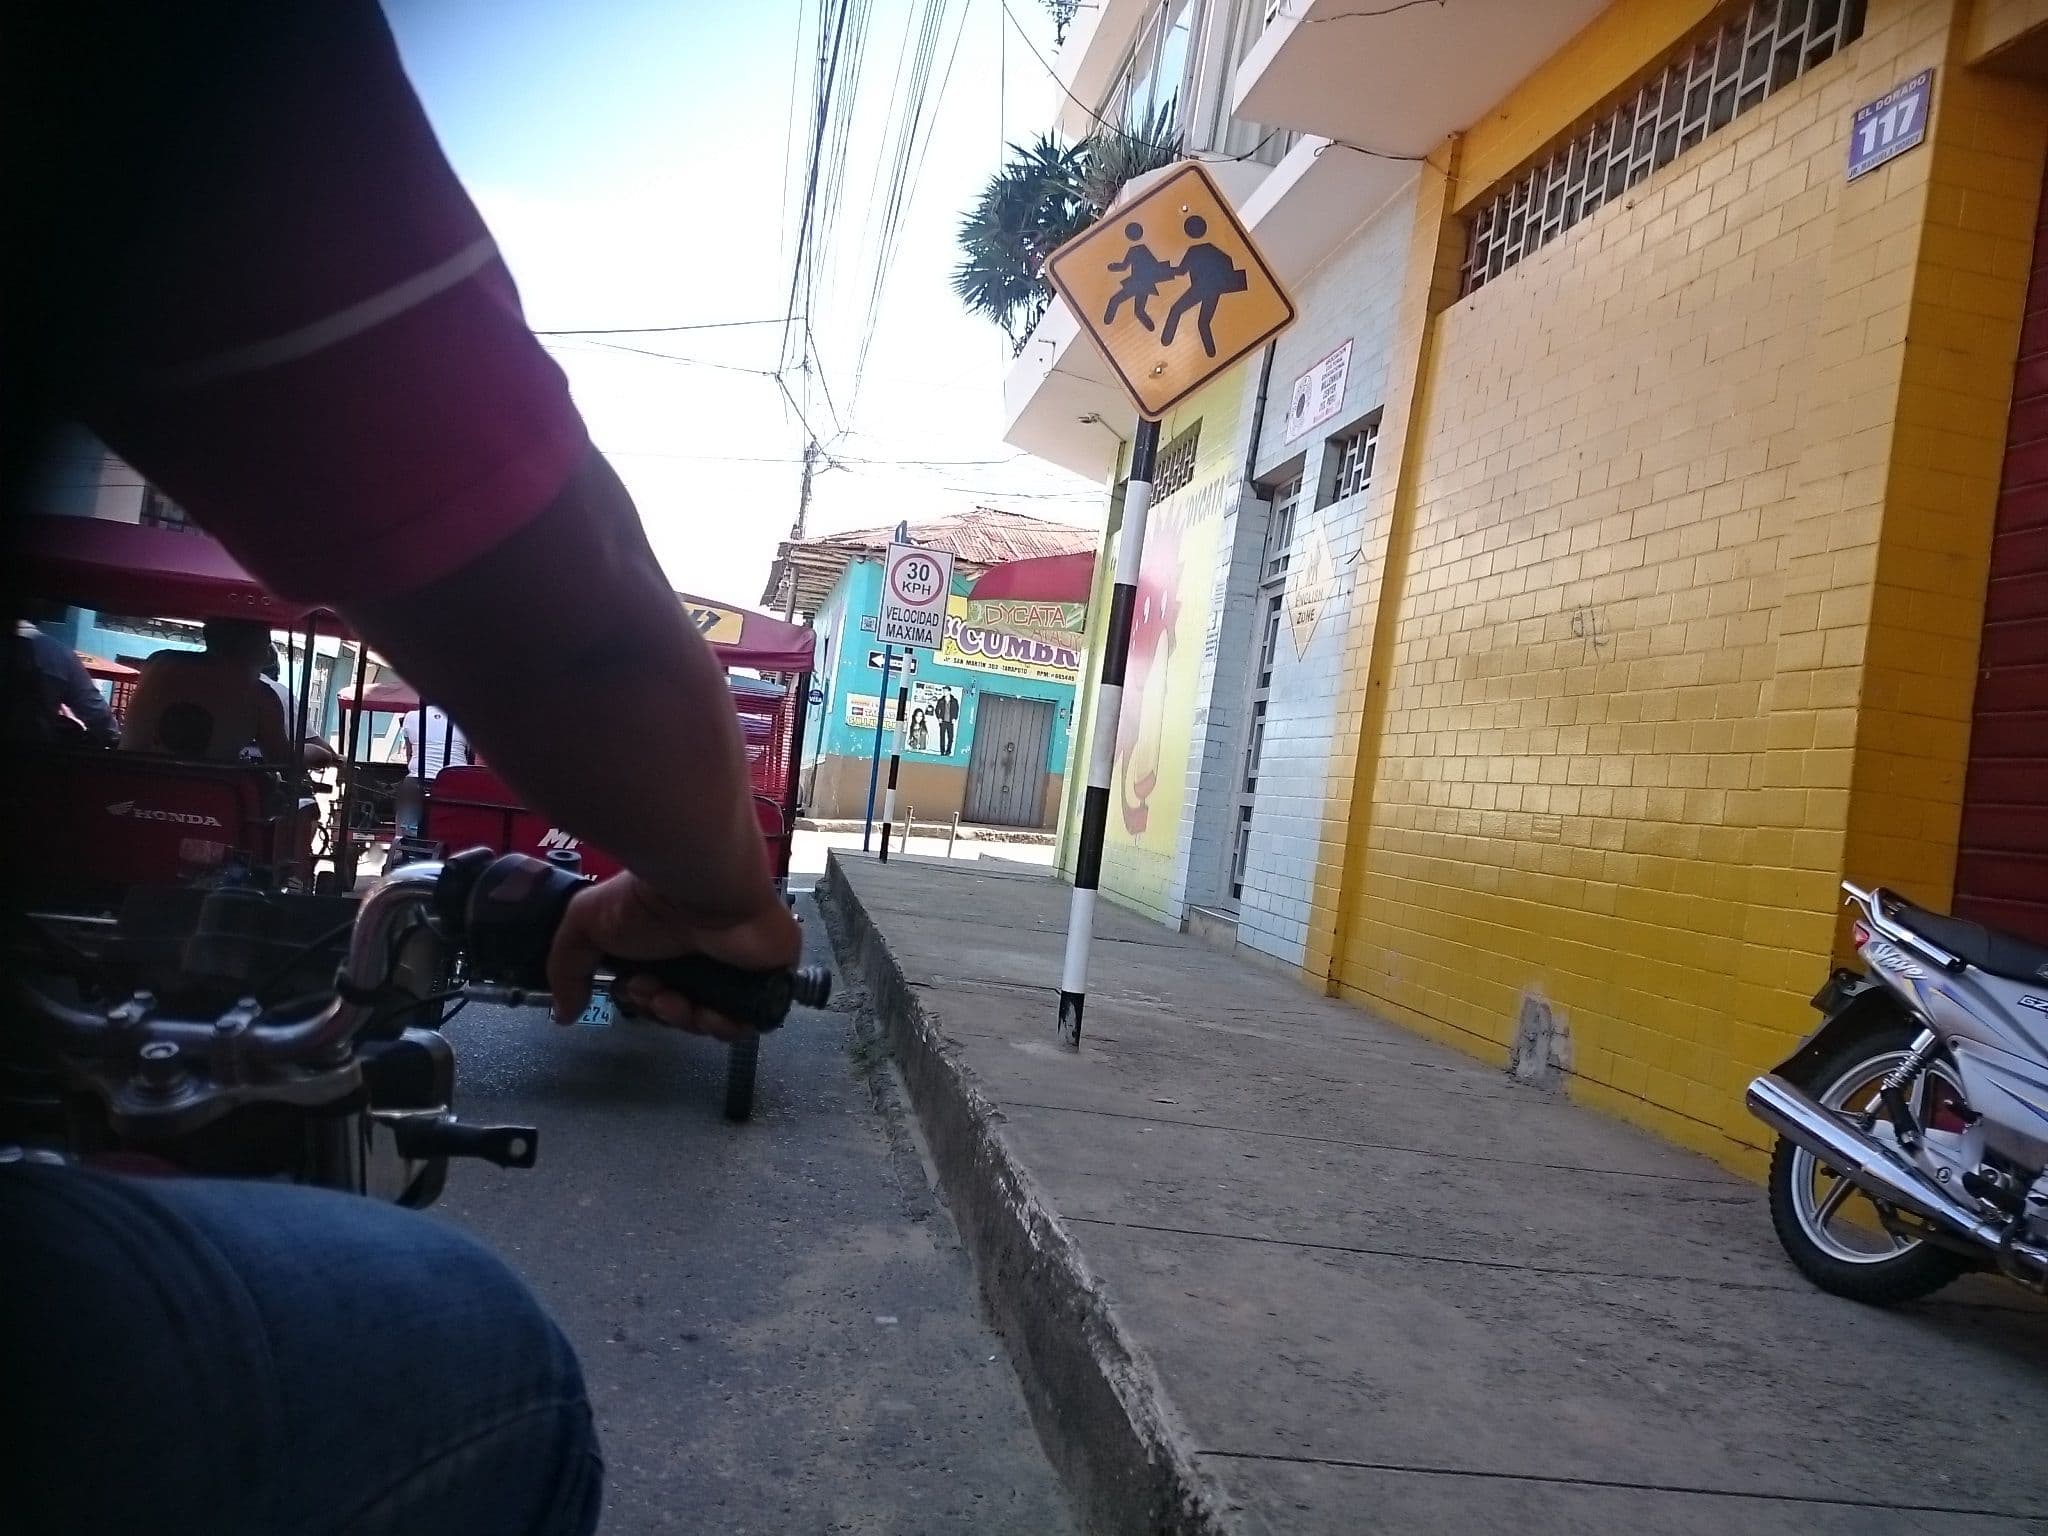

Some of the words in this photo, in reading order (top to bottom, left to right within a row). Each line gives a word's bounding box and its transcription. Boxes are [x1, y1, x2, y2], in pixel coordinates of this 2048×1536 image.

[1858, 108, 1873, 122] EL
[1875, 75, 1926, 112] DORADO
[1859, 93, 1920, 156] 117
[907, 562, 930, 581] 30
[902, 581, 931, 595] KPH
[886, 605, 940, 627] VELOCIDAD
[985, 604, 1066, 628] DYCATA
[1296, 609, 1315, 625] ZONE
[885, 623, 933, 643] MAXIMA
[134, 808, 222, 827] HONDA
